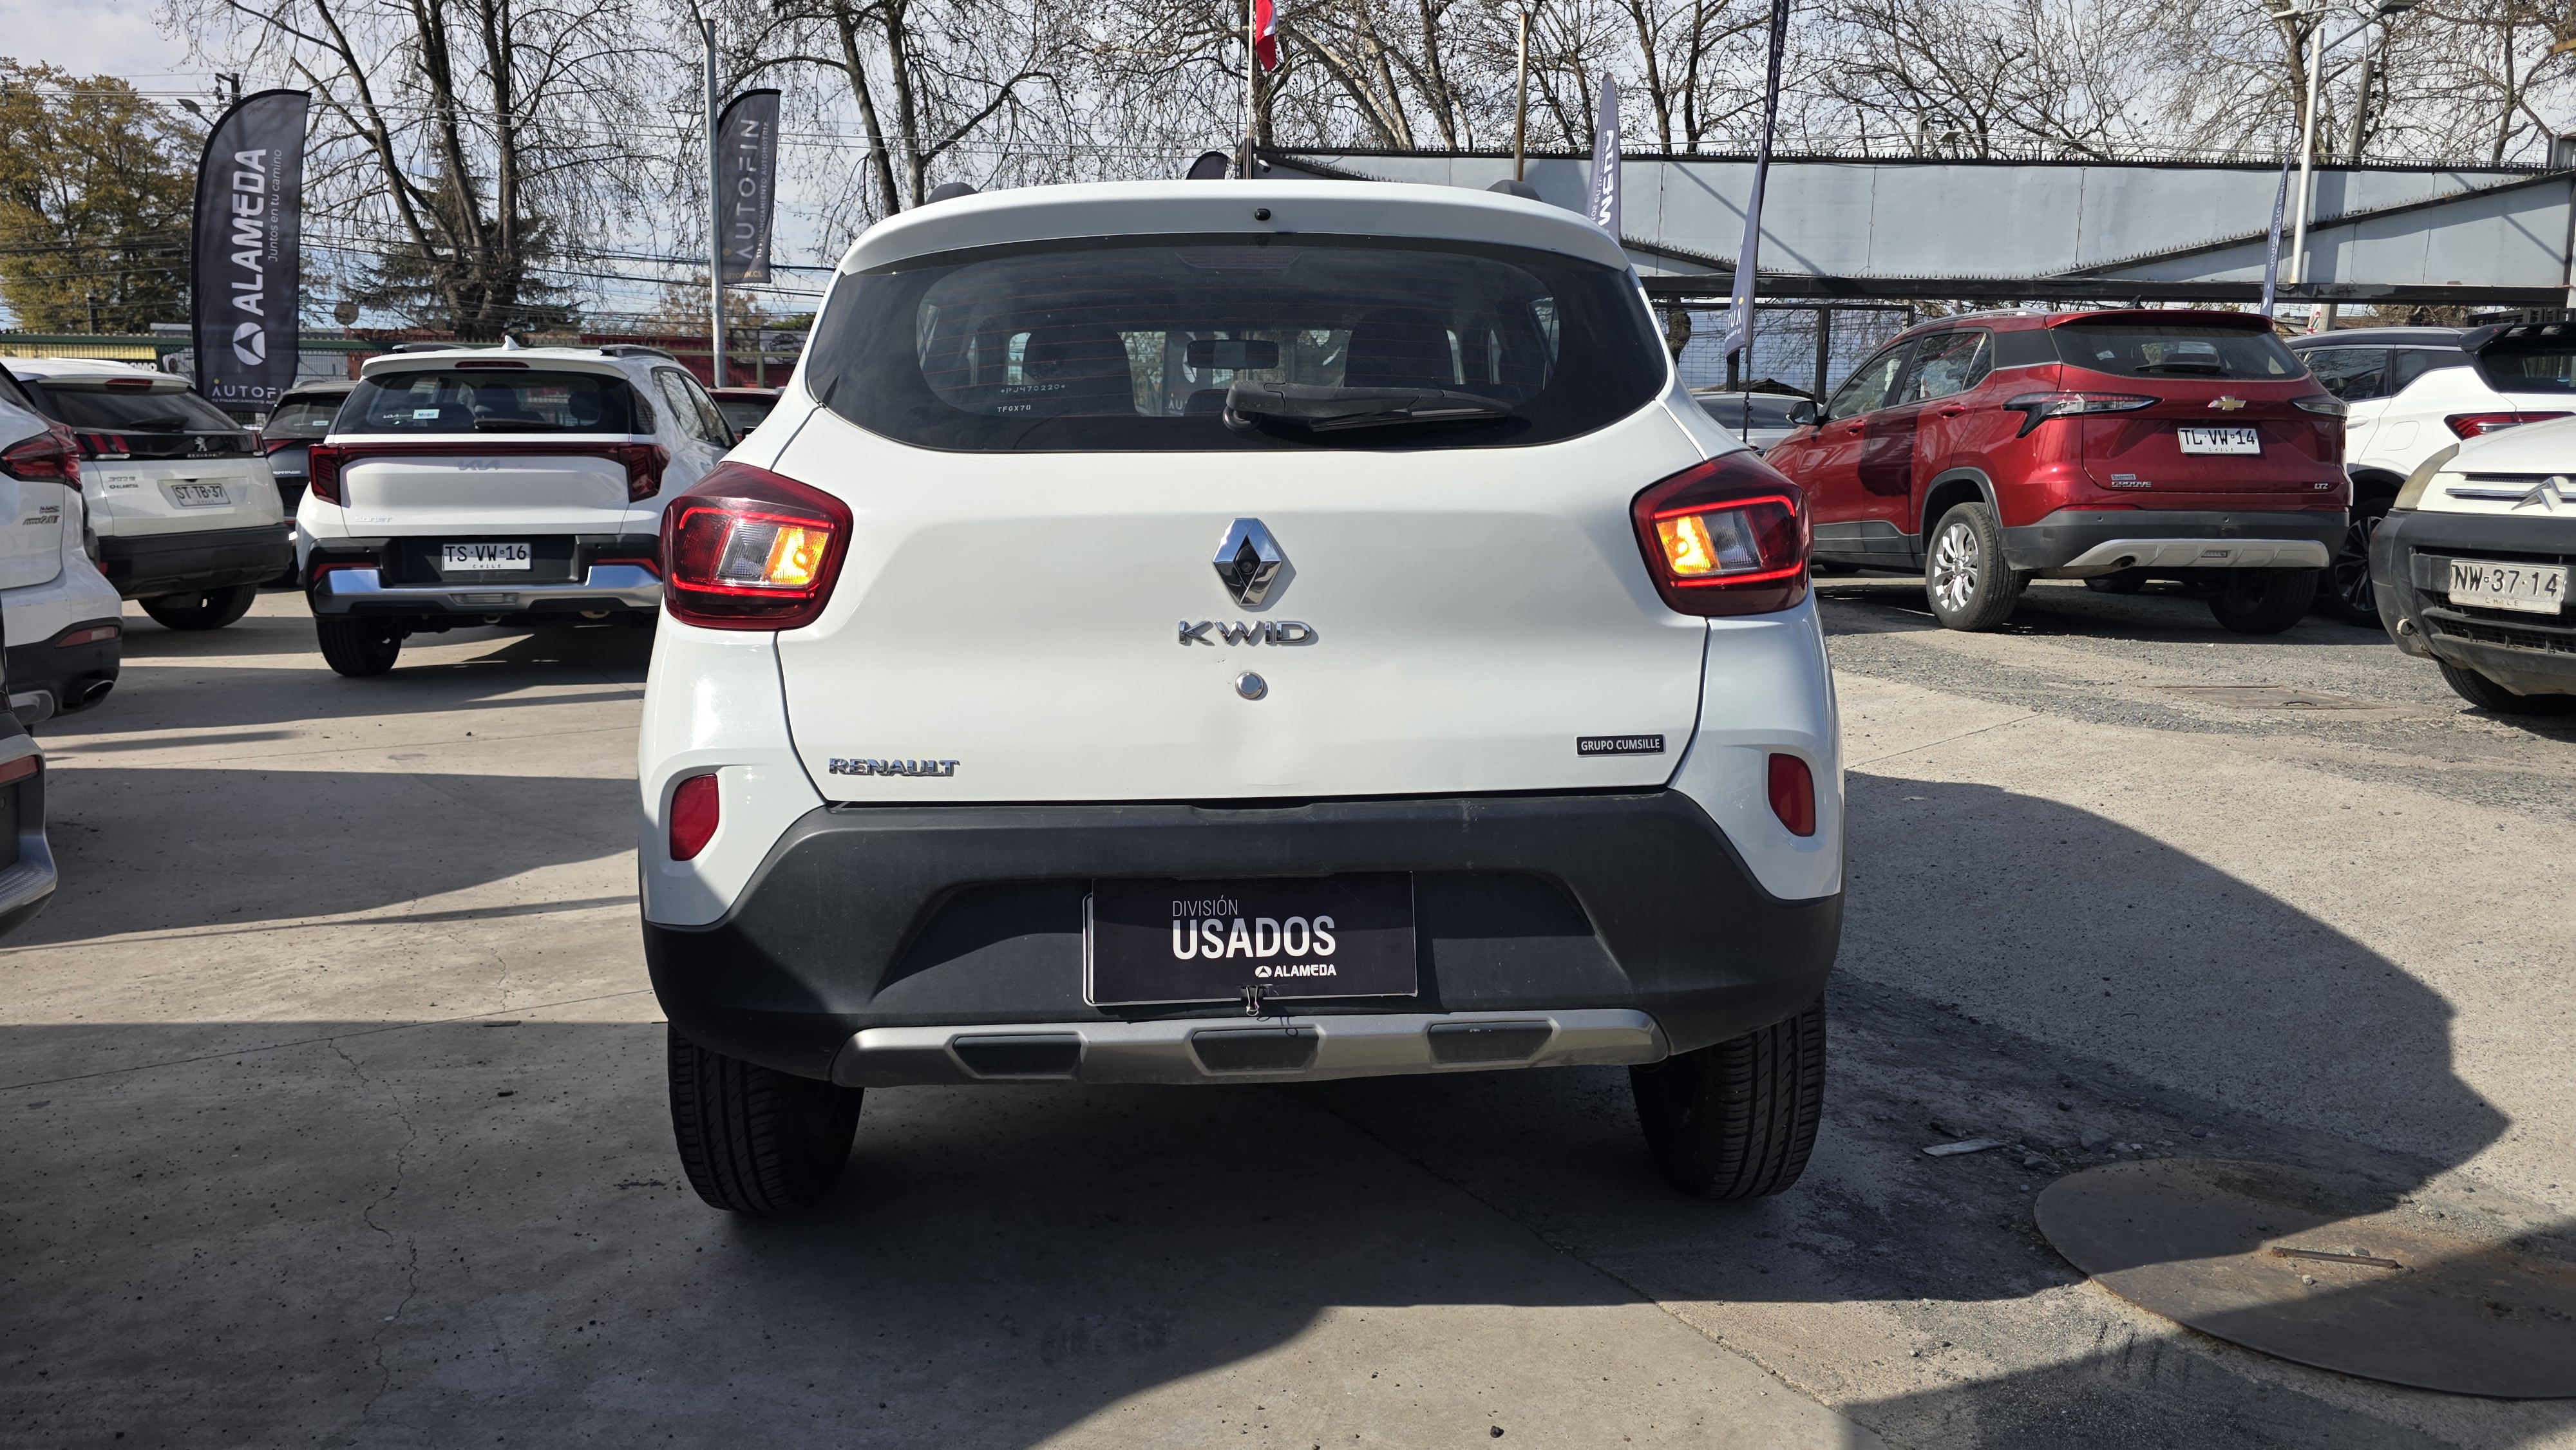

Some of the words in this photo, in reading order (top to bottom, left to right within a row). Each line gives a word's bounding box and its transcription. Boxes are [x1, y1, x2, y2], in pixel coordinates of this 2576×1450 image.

[270, 149, 282, 192] camino
[272, 194, 279, 206] tu
[735, 120, 759, 259] AUTOFIN
[270, 208, 279, 223] en
[231, 149, 267, 317] ALAMEDA
[268, 225, 278, 262] Juntos
[212, 385, 283, 399] AUTOFI
[2485, 597, 2520, 607] CHILE
[1178, 620, 1311, 645] KWID
[1581, 740, 1614, 751] GRUPO
[1616, 739, 1660, 750] CUMSILLE
[829, 757, 960, 777] RENAULT
[1172, 894, 1238, 917] DIVISIÓN
[1173, 915, 1336, 960] USADOS
[1274, 965, 1337, 977] ALAMEDA
